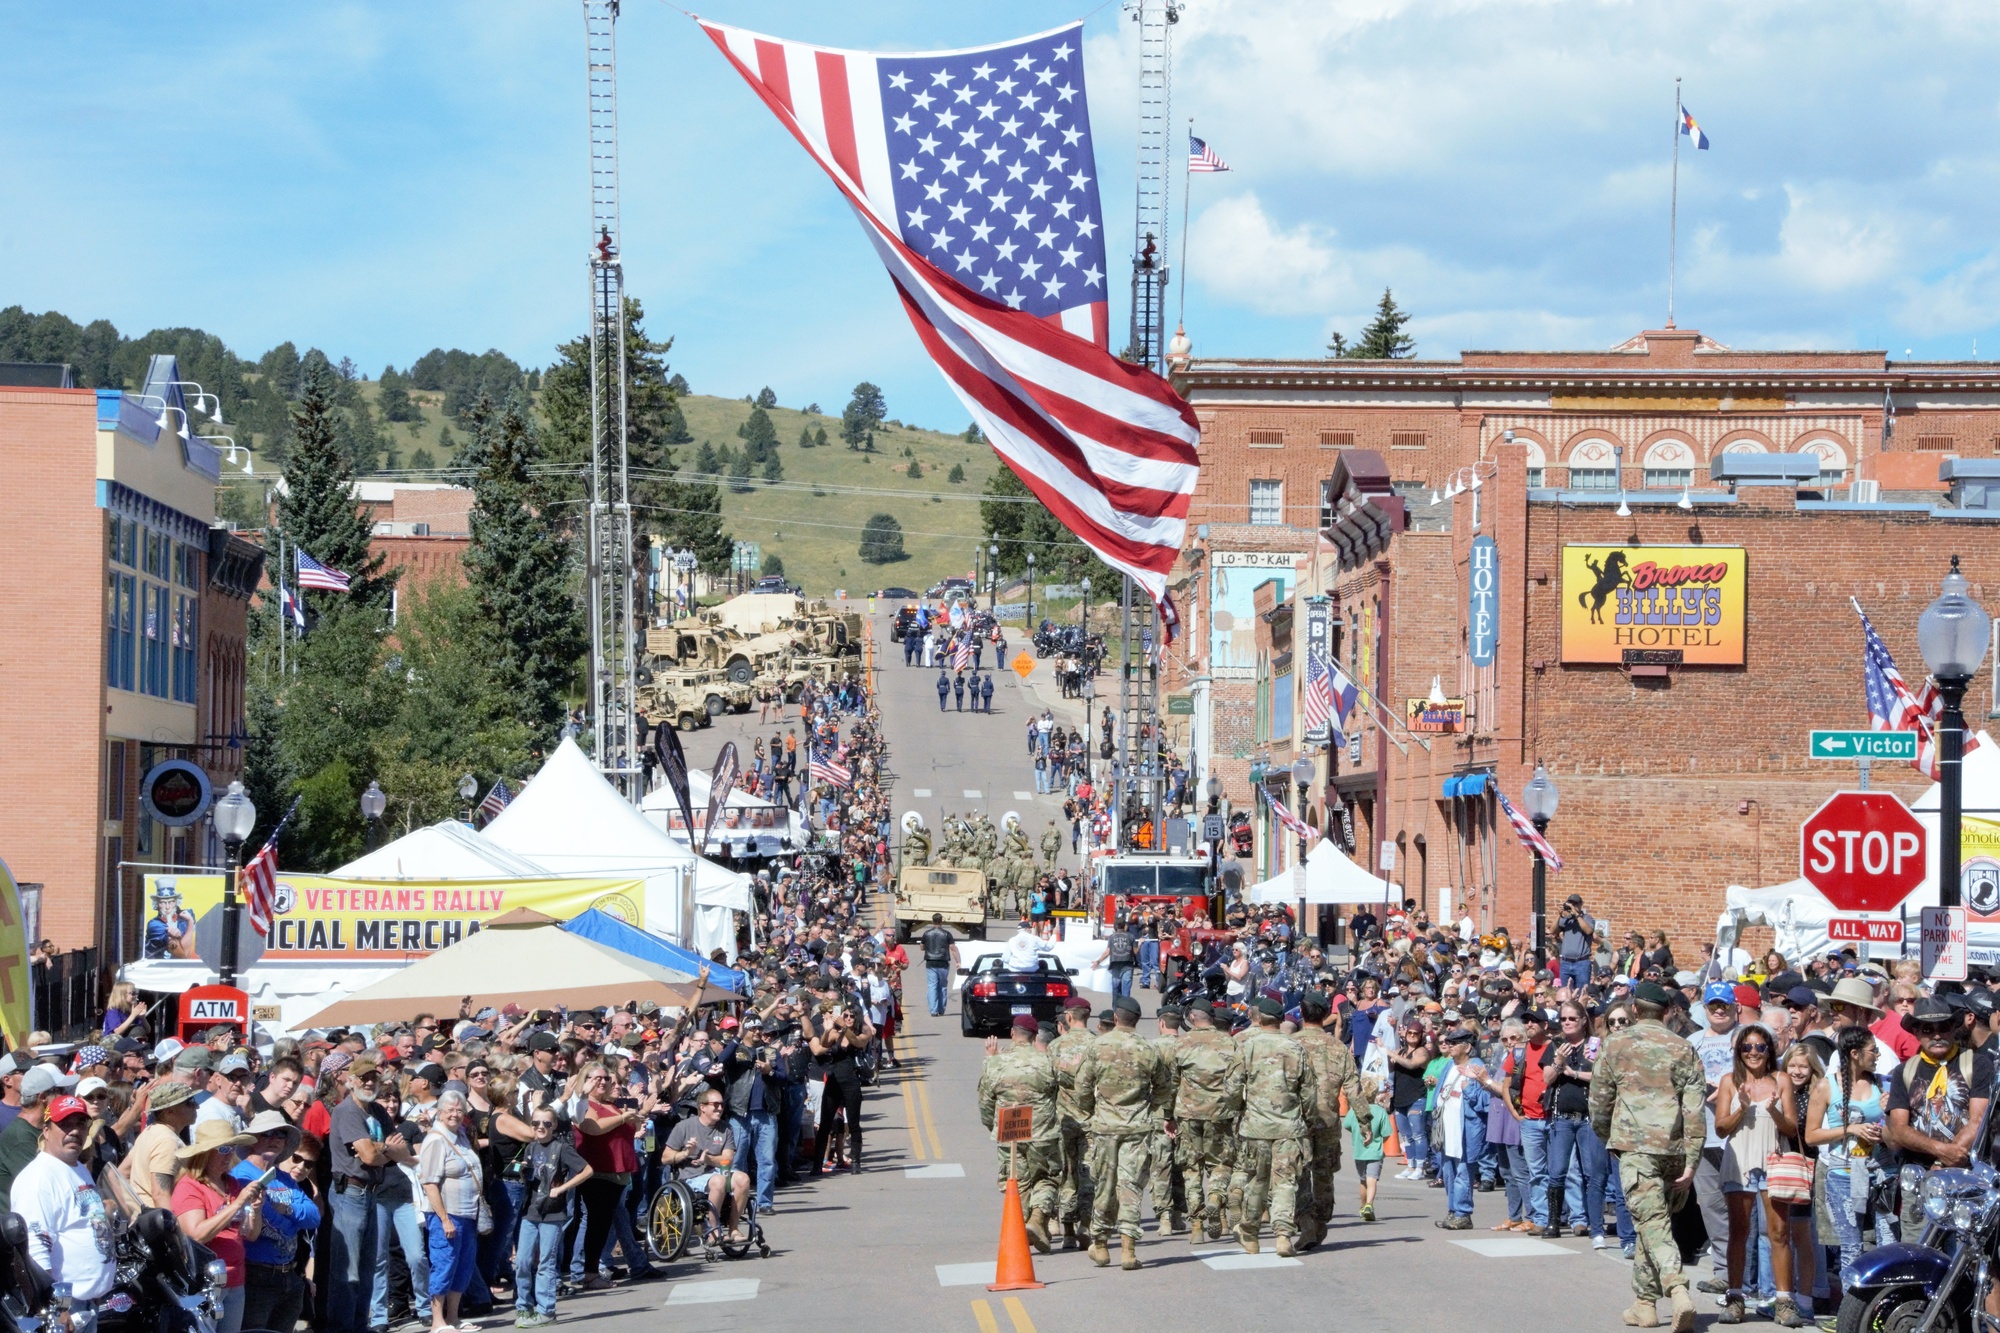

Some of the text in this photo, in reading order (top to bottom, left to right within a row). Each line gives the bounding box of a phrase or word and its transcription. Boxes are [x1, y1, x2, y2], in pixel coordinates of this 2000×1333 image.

[1244, 554, 1258, 564] TO
[1267, 555, 1290, 565] KAH
[1632, 561, 1728, 590] Bronco
[1474, 546, 1492, 658] HOTEL
[1615, 583, 1722, 626] BILLY'S
[1309, 610, 1326, 618] OPERA
[1613, 627, 1722, 646] HOTEL
[1852, 737, 1913, 754] Victor
[1208, 827, 1219, 836] 15
[1810, 829, 1920, 875] STOP
[304, 889, 505, 912] VETERANS RALLY
[620, 898, 636, 922] ROCKIES
[1935, 913, 1952, 927] NO
[266, 919, 484, 951] ICIAL MERCHA
[1833, 922, 1897, 939] ALL WAY
[1923, 929, 1963, 943] PARKING
[1935, 944, 1952, 954] ANY
[1934, 954, 1953, 964] TIME
[193, 1001, 235, 1017] ATM
[1012, 1109, 1022, 1118] NO
[1004, 1118, 1029, 1130] CENTER
[1002, 1129, 1032, 1140] PARKING
